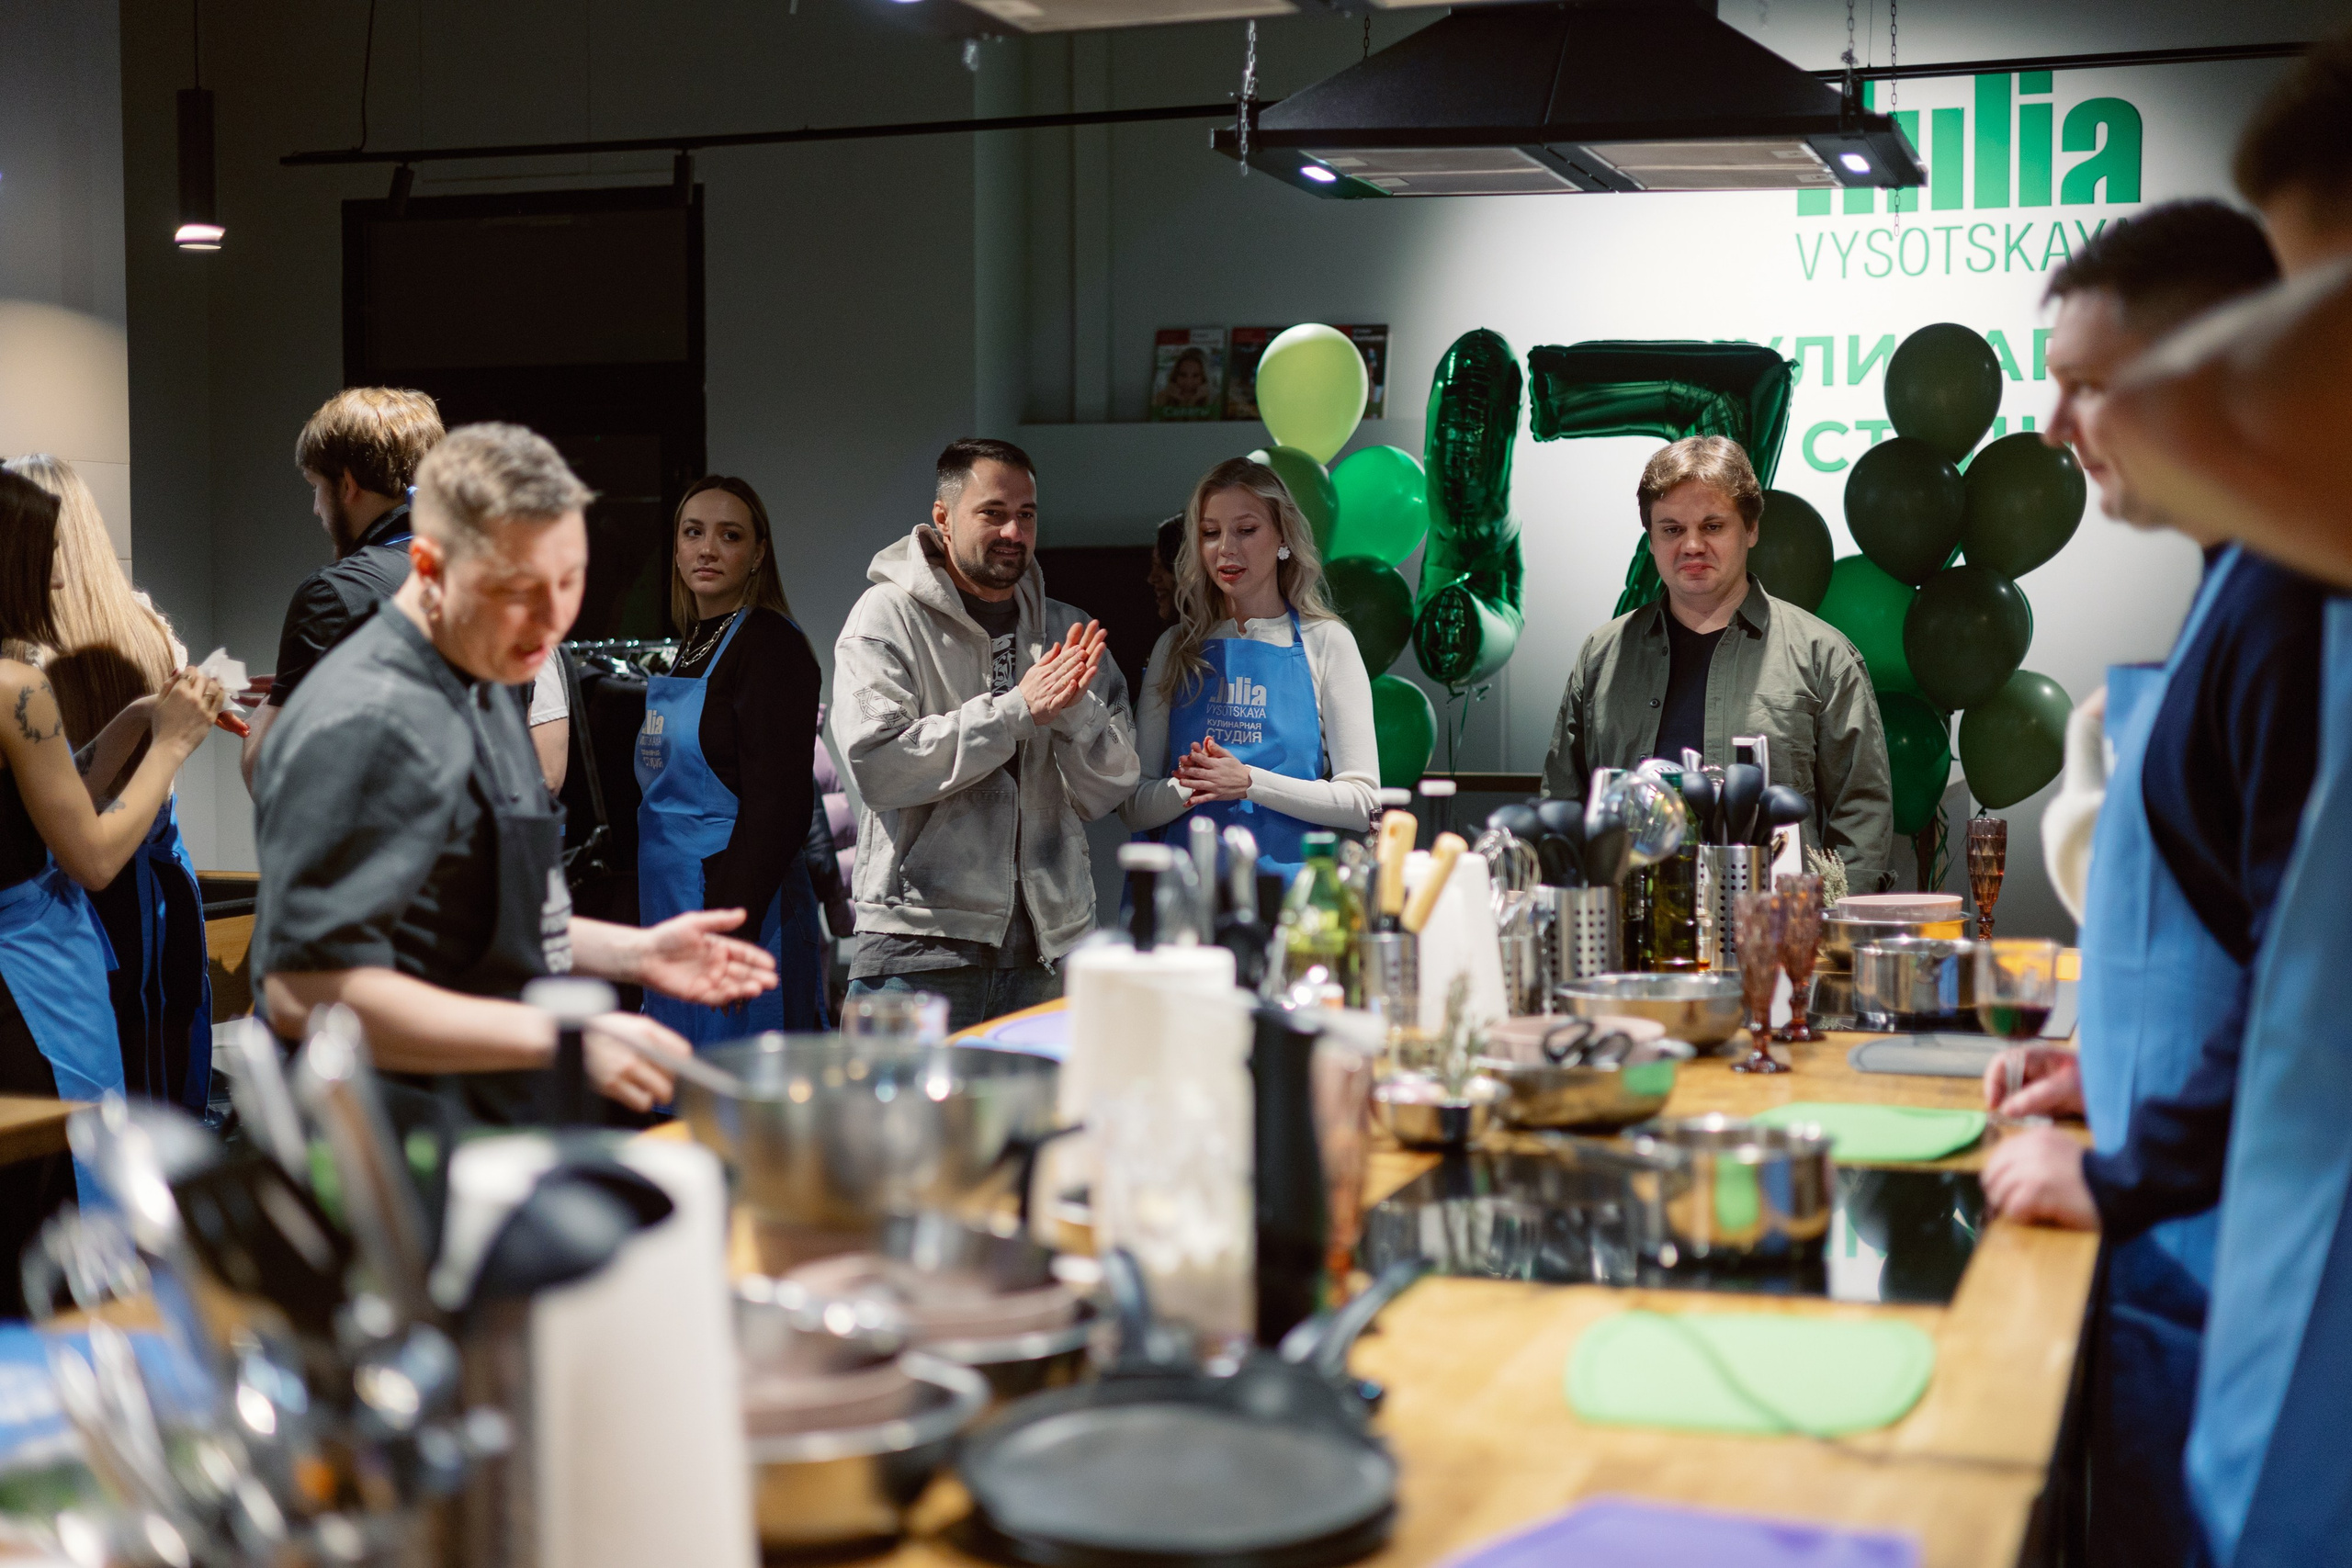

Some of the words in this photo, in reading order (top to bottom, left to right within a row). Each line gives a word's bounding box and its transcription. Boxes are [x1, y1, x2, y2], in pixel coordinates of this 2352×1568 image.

[1796, 217, 2131, 279] VYSOTSKAY
[1209, 676, 1267, 706] Julia
[1206, 703, 1267, 719] VYSOTSKAYA
[1207, 718, 1262, 730] КУЛИНАРНАЯ
[1206, 728, 1262, 745] СТУДИЯ
